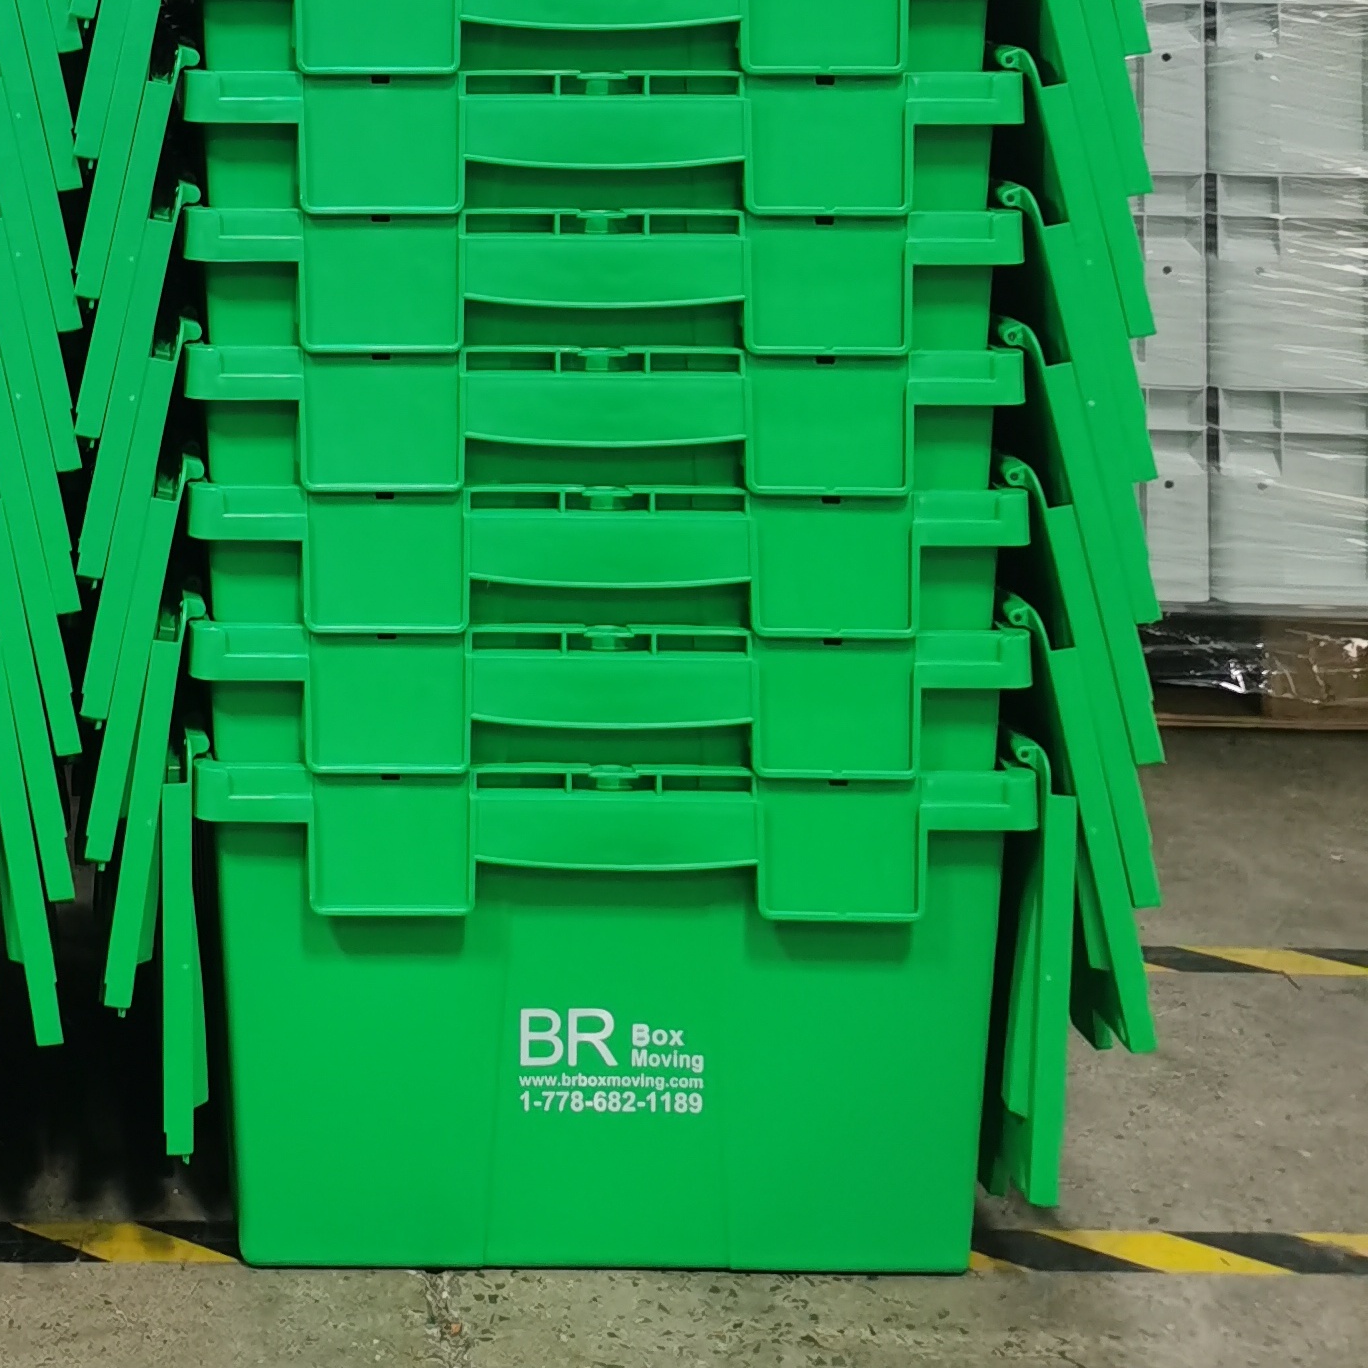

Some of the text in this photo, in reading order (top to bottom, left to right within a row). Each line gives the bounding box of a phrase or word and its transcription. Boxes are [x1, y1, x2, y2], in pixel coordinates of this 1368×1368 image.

[520, 1008, 618, 1067] BR
[632, 1023, 684, 1047] Box
[631, 1048, 704, 1073] Moving
[519, 1073, 704, 1091] www.brboxmoving.com
[520, 1091, 703, 1113] 1-778-682-1189
